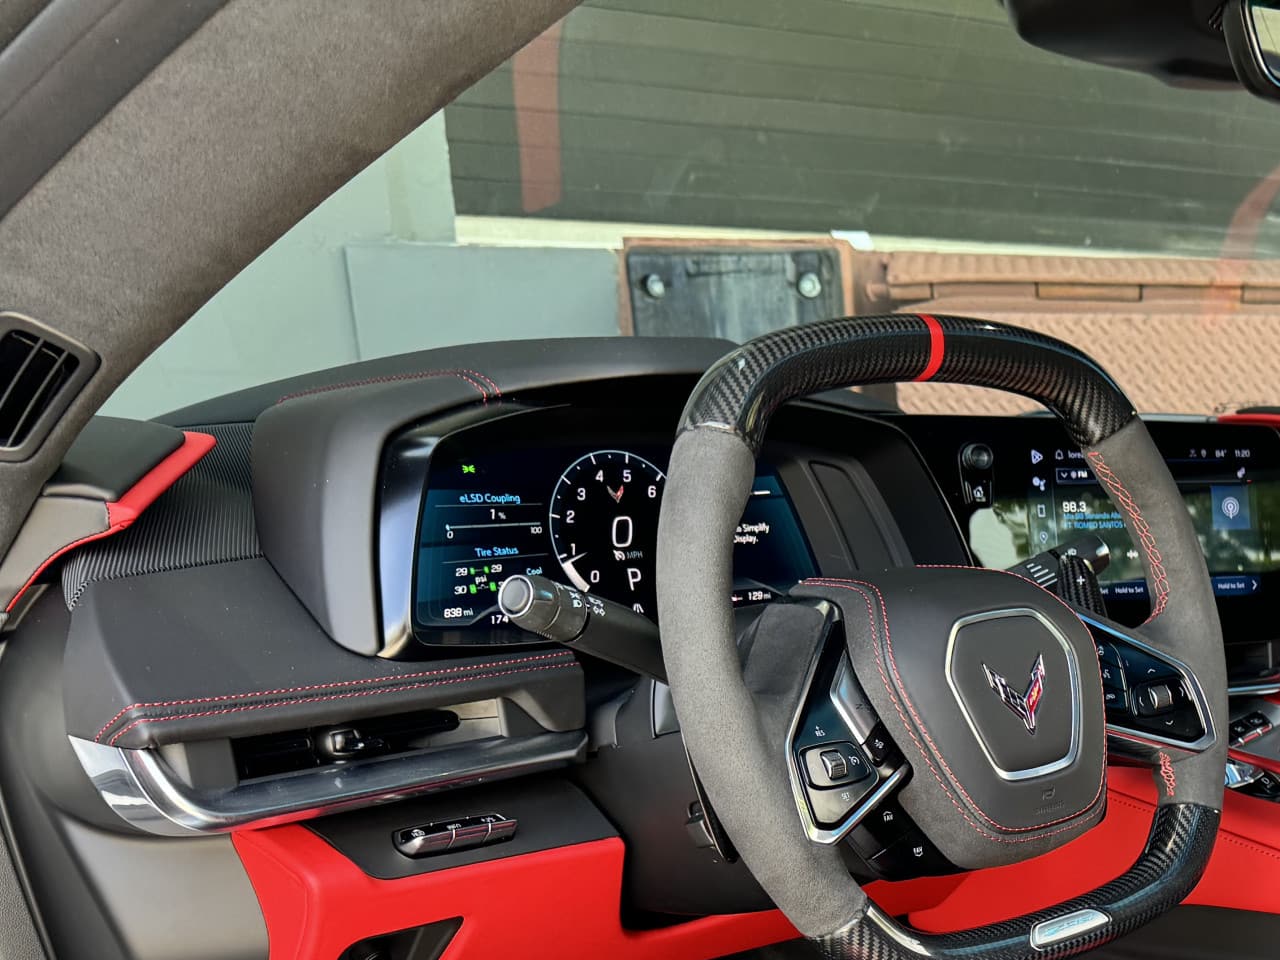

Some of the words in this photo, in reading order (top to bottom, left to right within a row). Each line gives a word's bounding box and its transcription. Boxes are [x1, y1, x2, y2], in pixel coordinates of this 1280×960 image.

[595, 469, 604, 483] 4
[623, 469, 632, 483] 5
[576, 487, 586, 501] 3
[647, 485, 657, 498] 6
[459, 493, 483, 503] eLSD
[484, 493, 521, 504] Coupling
[1062, 501, 1087, 513] 98.3
[490, 508, 496, 520] 1
[566, 510, 575, 523] 2
[446, 531, 454, 539] 0
[530, 526, 542, 534] 100
[612, 515, 633, 548] 0
[474, 547, 492, 557] Tire
[493, 546, 519, 556] Status
[570, 543, 576, 556] 1
[626, 551, 644, 560] MPH
[455, 567, 468, 577] 29
[491, 564, 503, 573] 29
[526, 566, 543, 576] Cool
[475, 575, 488, 585] psi
[590, 570, 600, 583] 0
[626, 567, 642, 591] P
[454, 585, 468, 595] 30
[748, 591, 763, 601] 129
[443, 607, 463, 618] 838
[463, 608, 474, 616] mi
